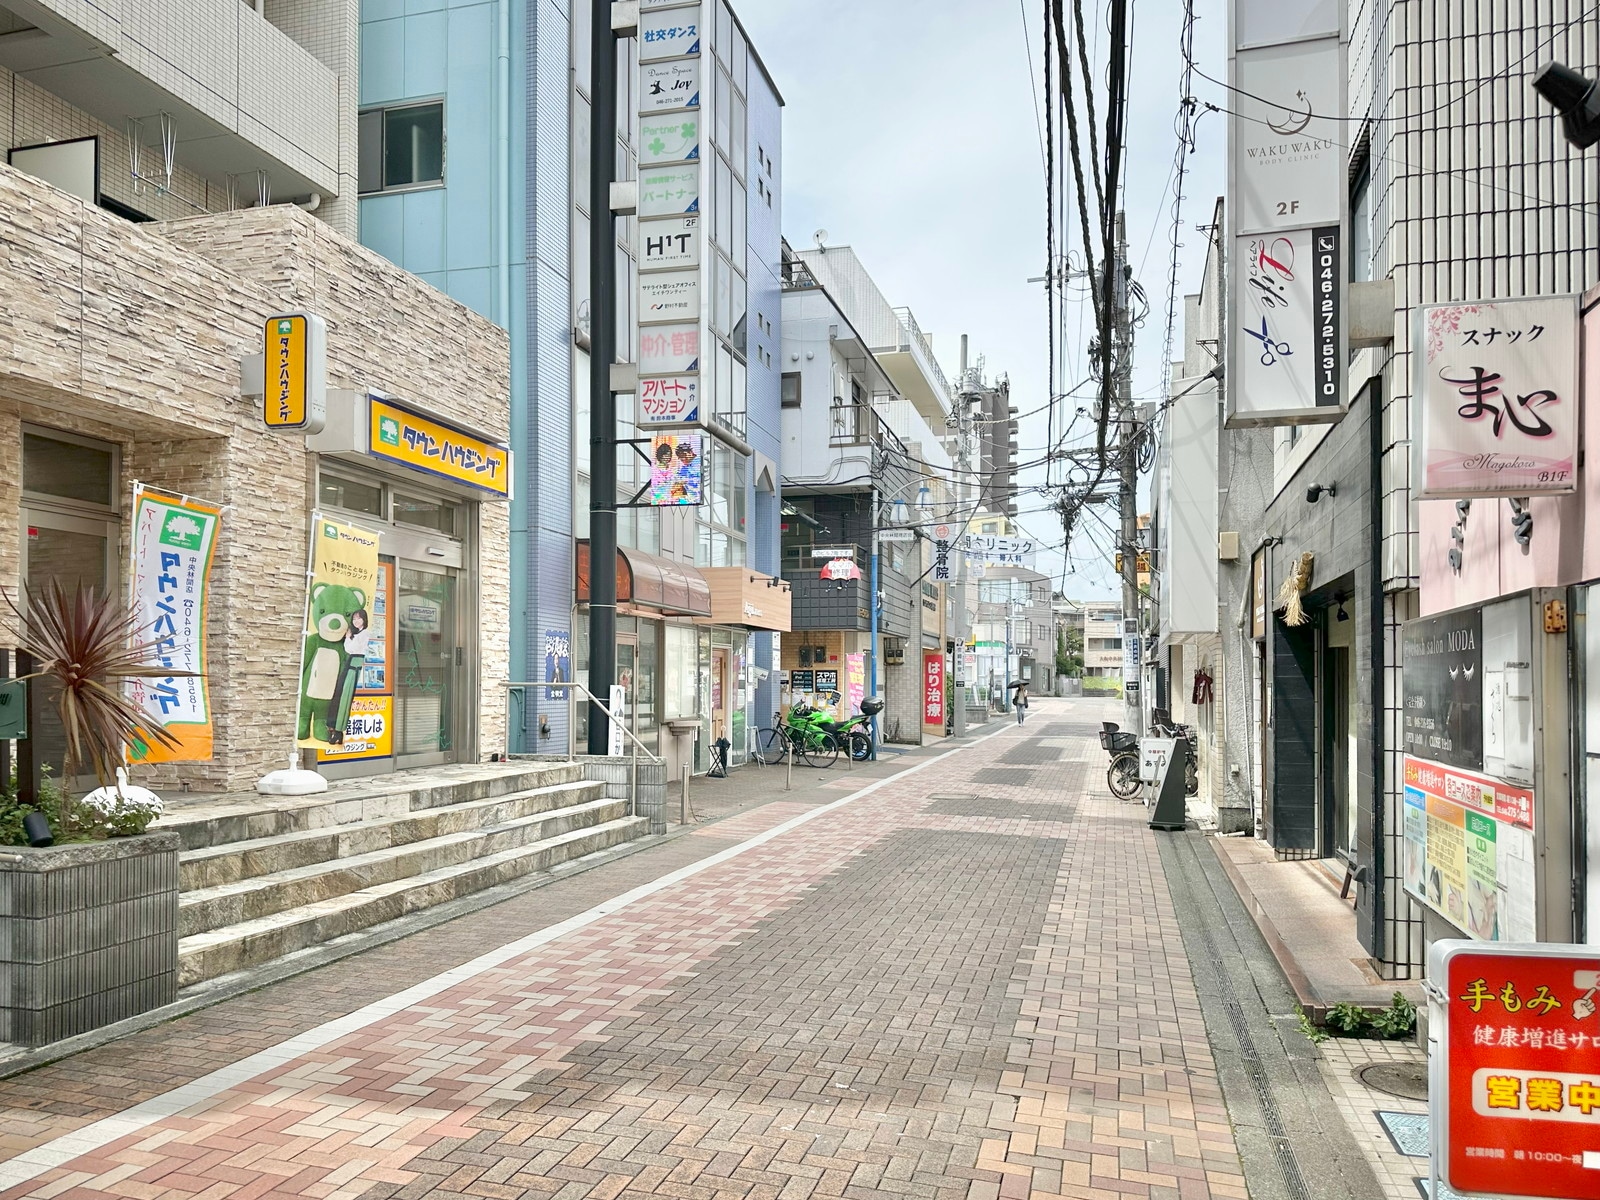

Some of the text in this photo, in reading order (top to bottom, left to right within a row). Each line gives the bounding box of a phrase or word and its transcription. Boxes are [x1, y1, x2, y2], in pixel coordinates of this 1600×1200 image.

[644, 25, 697, 42] 社交ダンス
[648, 65, 692, 77] Dance Space
[671, 80, 692, 90] Joy
[643, 125, 679, 136] Partner
[1247, 138, 1333, 159] WAKU WAKU
[1259, 153, 1321, 166] BODY CLINIC
[643, 188, 697, 202] パートナー
[1276, 200, 1300, 216] 2F
[686, 218, 697, 227] 2F
[1461, 324, 1545, 347] スナック
[278, 337, 293, 422] タウンハウジング
[642, 379, 687, 397] アパート
[642, 397, 687, 415] マンション
[402, 425, 502, 479] タウンハウジング
[1462, 453, 1536, 473] Magokoro
[1537, 470, 1569, 483] B1F
[340, 532, 375, 547] タウンハウジング
[936, 539, 949, 579] 整骨院
[1427, 634, 1444, 655] salon
[1448, 628, 1476, 653] MODA
[927, 661, 941, 717] はり治療
[1460, 977, 1563, 1017] 手もみ
[1486, 1075, 1600, 1115] 営業中
